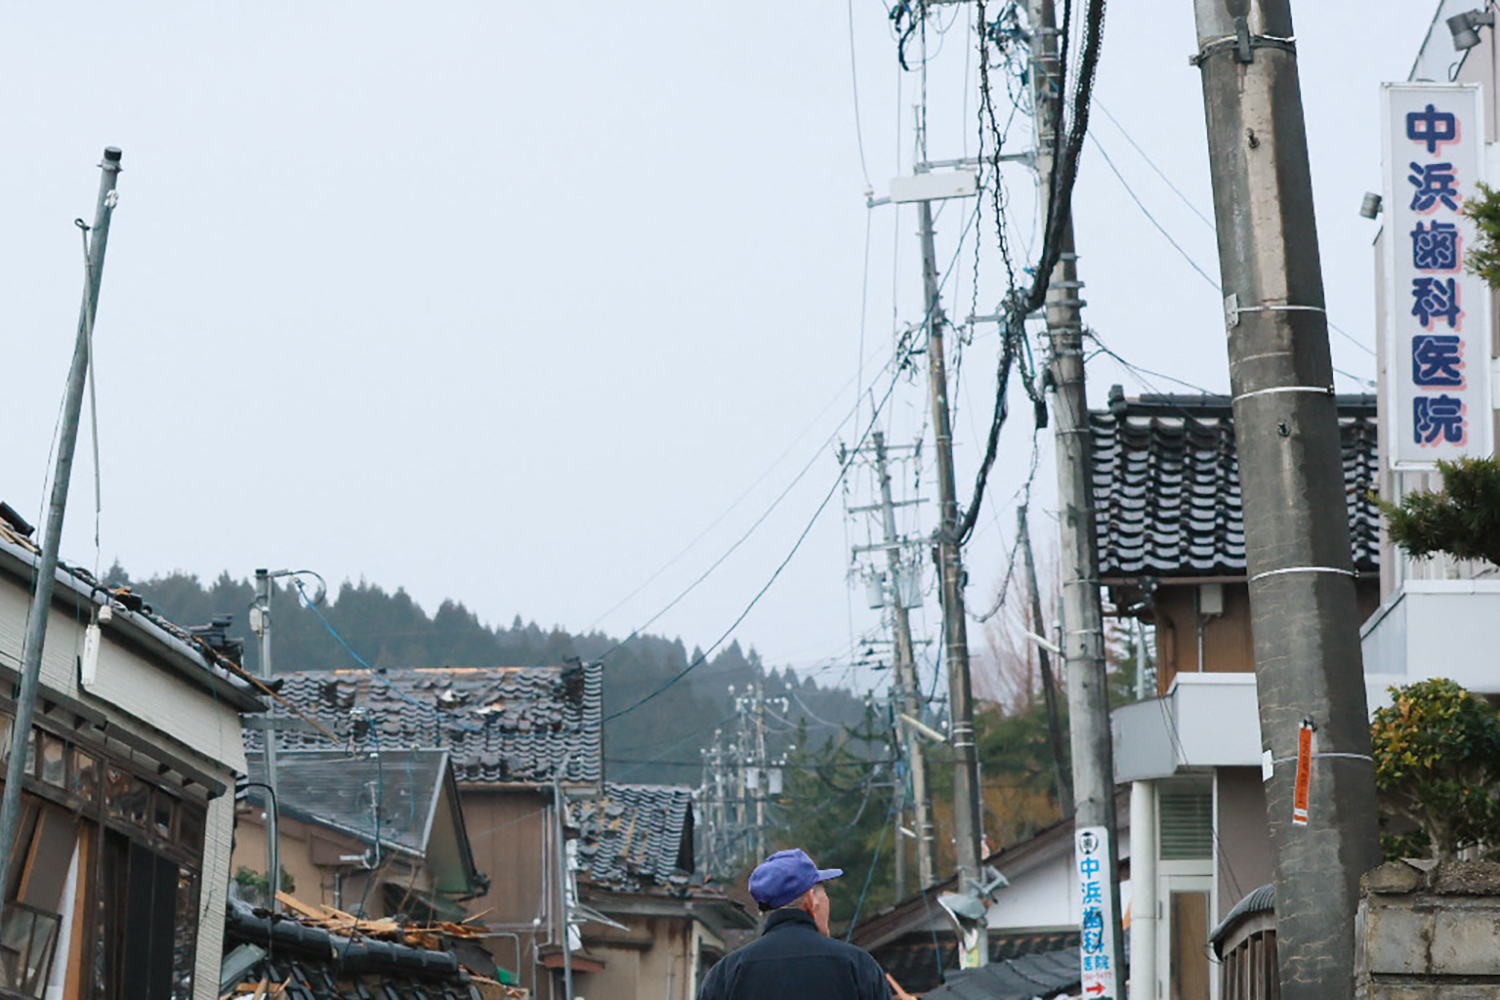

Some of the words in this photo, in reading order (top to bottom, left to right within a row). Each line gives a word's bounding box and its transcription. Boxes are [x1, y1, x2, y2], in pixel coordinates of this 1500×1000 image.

[1405, 103, 1465, 446] 中浜歯科医院
